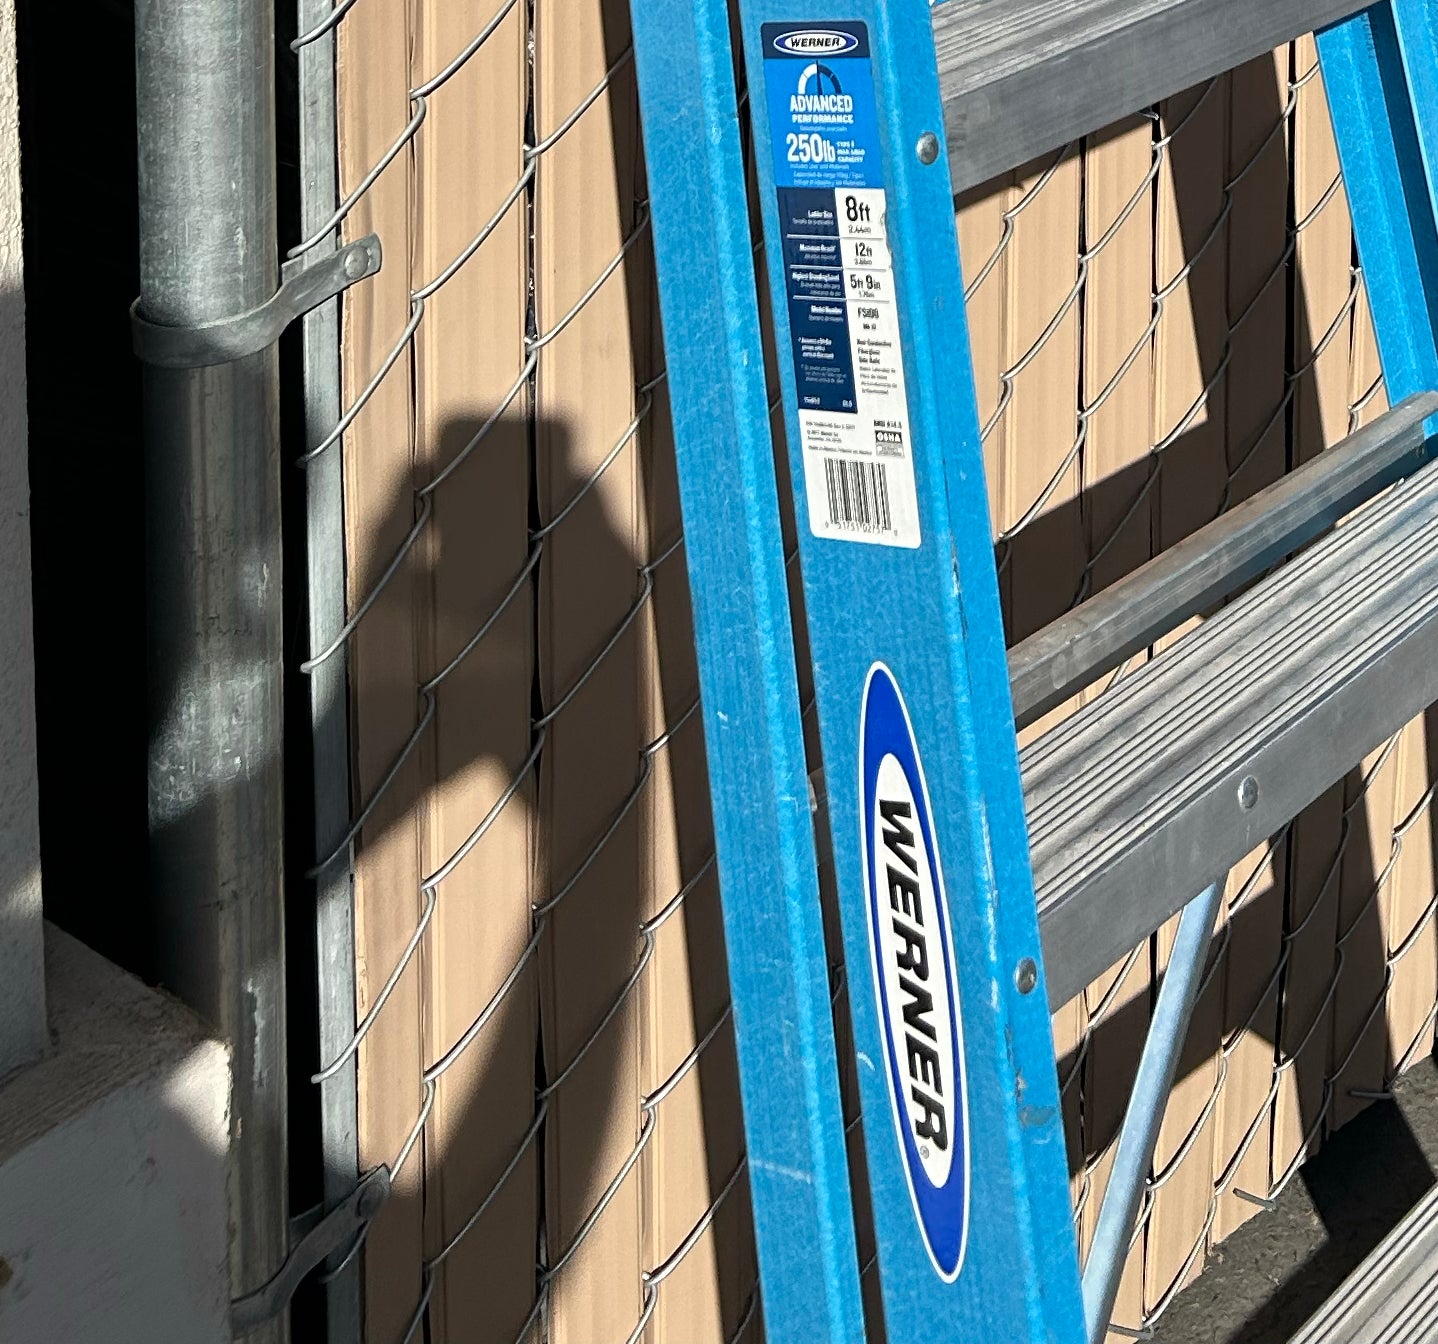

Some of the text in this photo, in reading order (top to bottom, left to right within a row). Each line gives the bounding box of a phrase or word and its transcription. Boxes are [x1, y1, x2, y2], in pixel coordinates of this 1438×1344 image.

[790, 37, 840, 48] WERNER
[790, 94, 853, 113] ADVANCED
[791, 114, 854, 124] PERFORMANCE
[786, 132, 836, 163] 250lb
[845, 195, 871, 222] 8ft
[855, 242, 873, 257] 12ft
[850, 274, 864, 289] 5ft
[876, 432, 901, 443] OSHA
[878, 797, 948, 1151] WERNER
